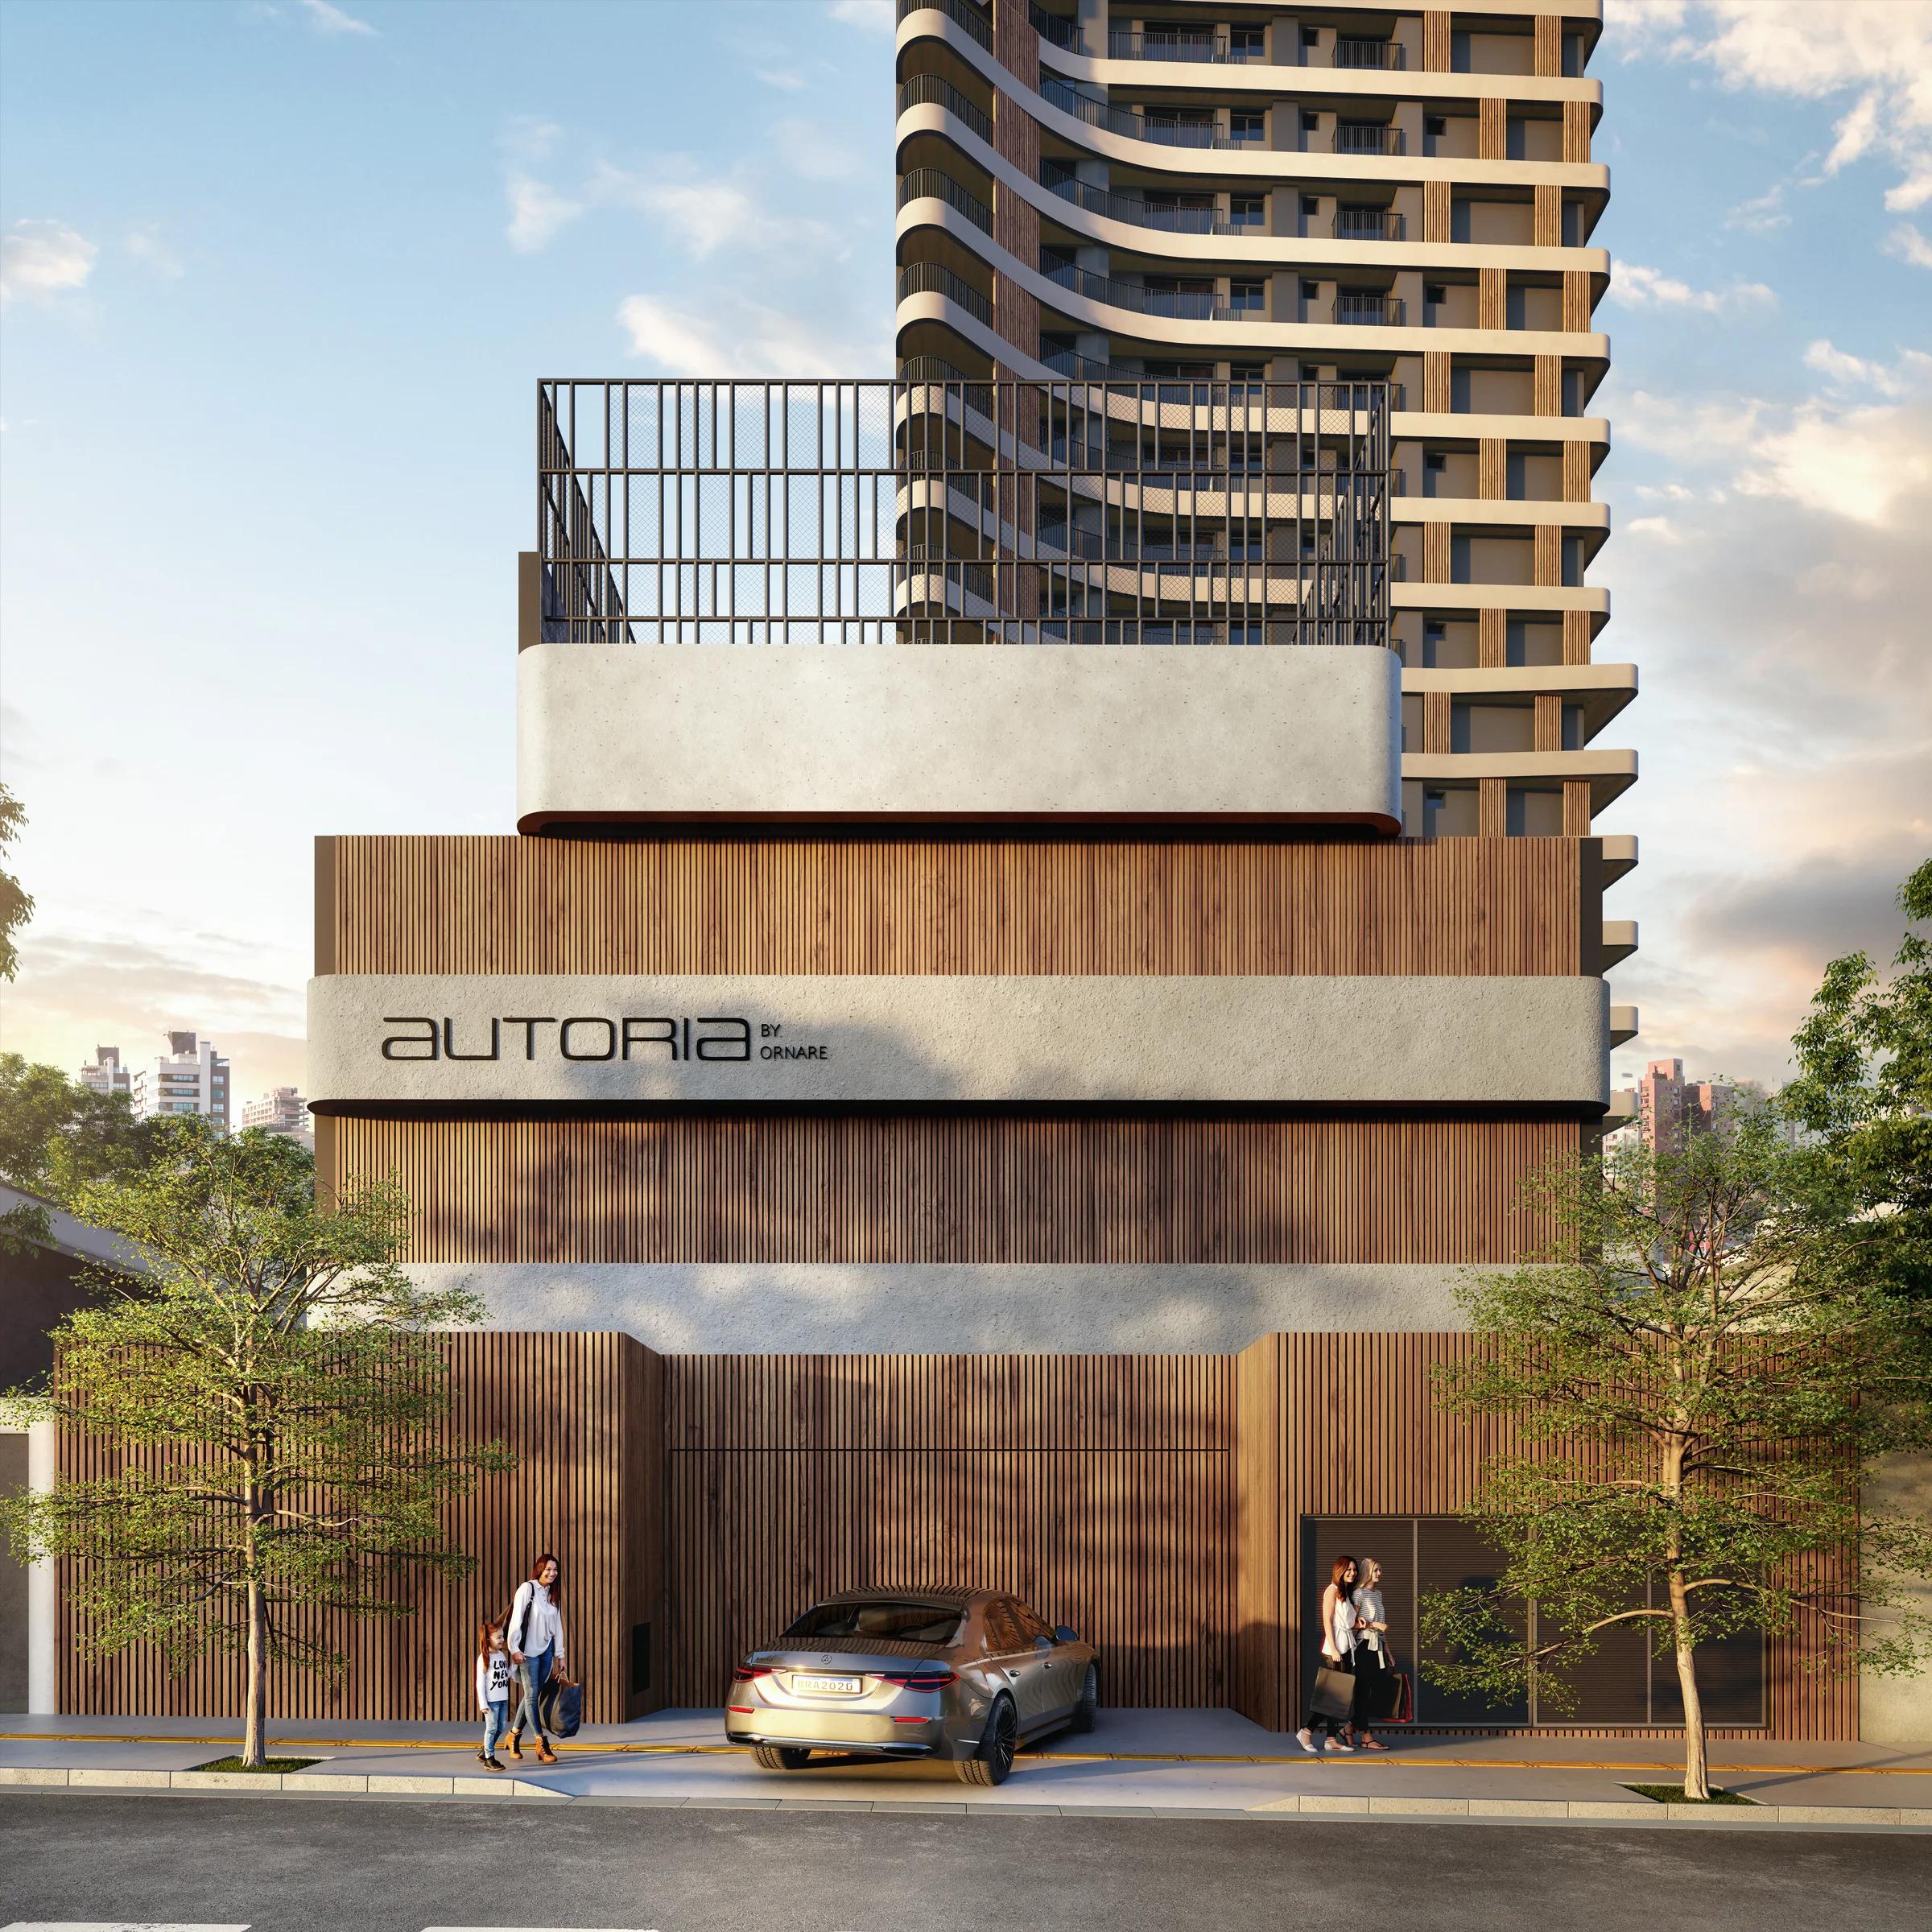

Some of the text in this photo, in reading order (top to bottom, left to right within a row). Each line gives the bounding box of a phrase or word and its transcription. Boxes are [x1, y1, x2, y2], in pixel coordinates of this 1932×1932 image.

[761, 1023, 781, 1038] BY
[760, 1046, 828, 1060] ORNARE
[493, 1659, 507, 1670] LOV
